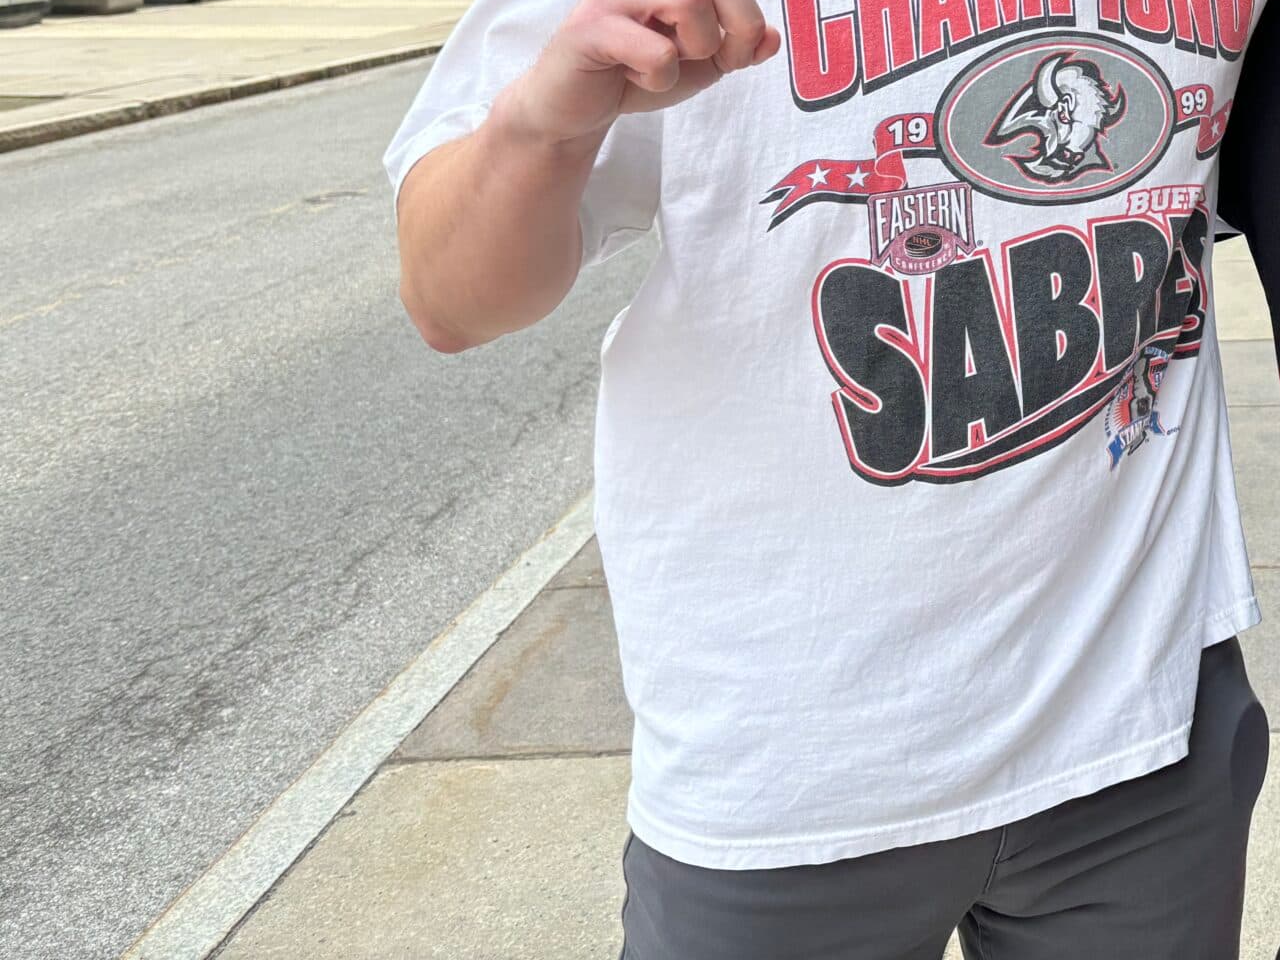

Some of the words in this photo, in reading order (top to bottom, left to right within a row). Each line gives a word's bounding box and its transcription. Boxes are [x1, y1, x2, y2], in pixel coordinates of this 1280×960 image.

[887, 119, 929, 144] 19
[1181, 88, 1207, 115] 99
[875, 187, 969, 257] EASTERN
[895, 248, 953, 271] CONFERENCE
